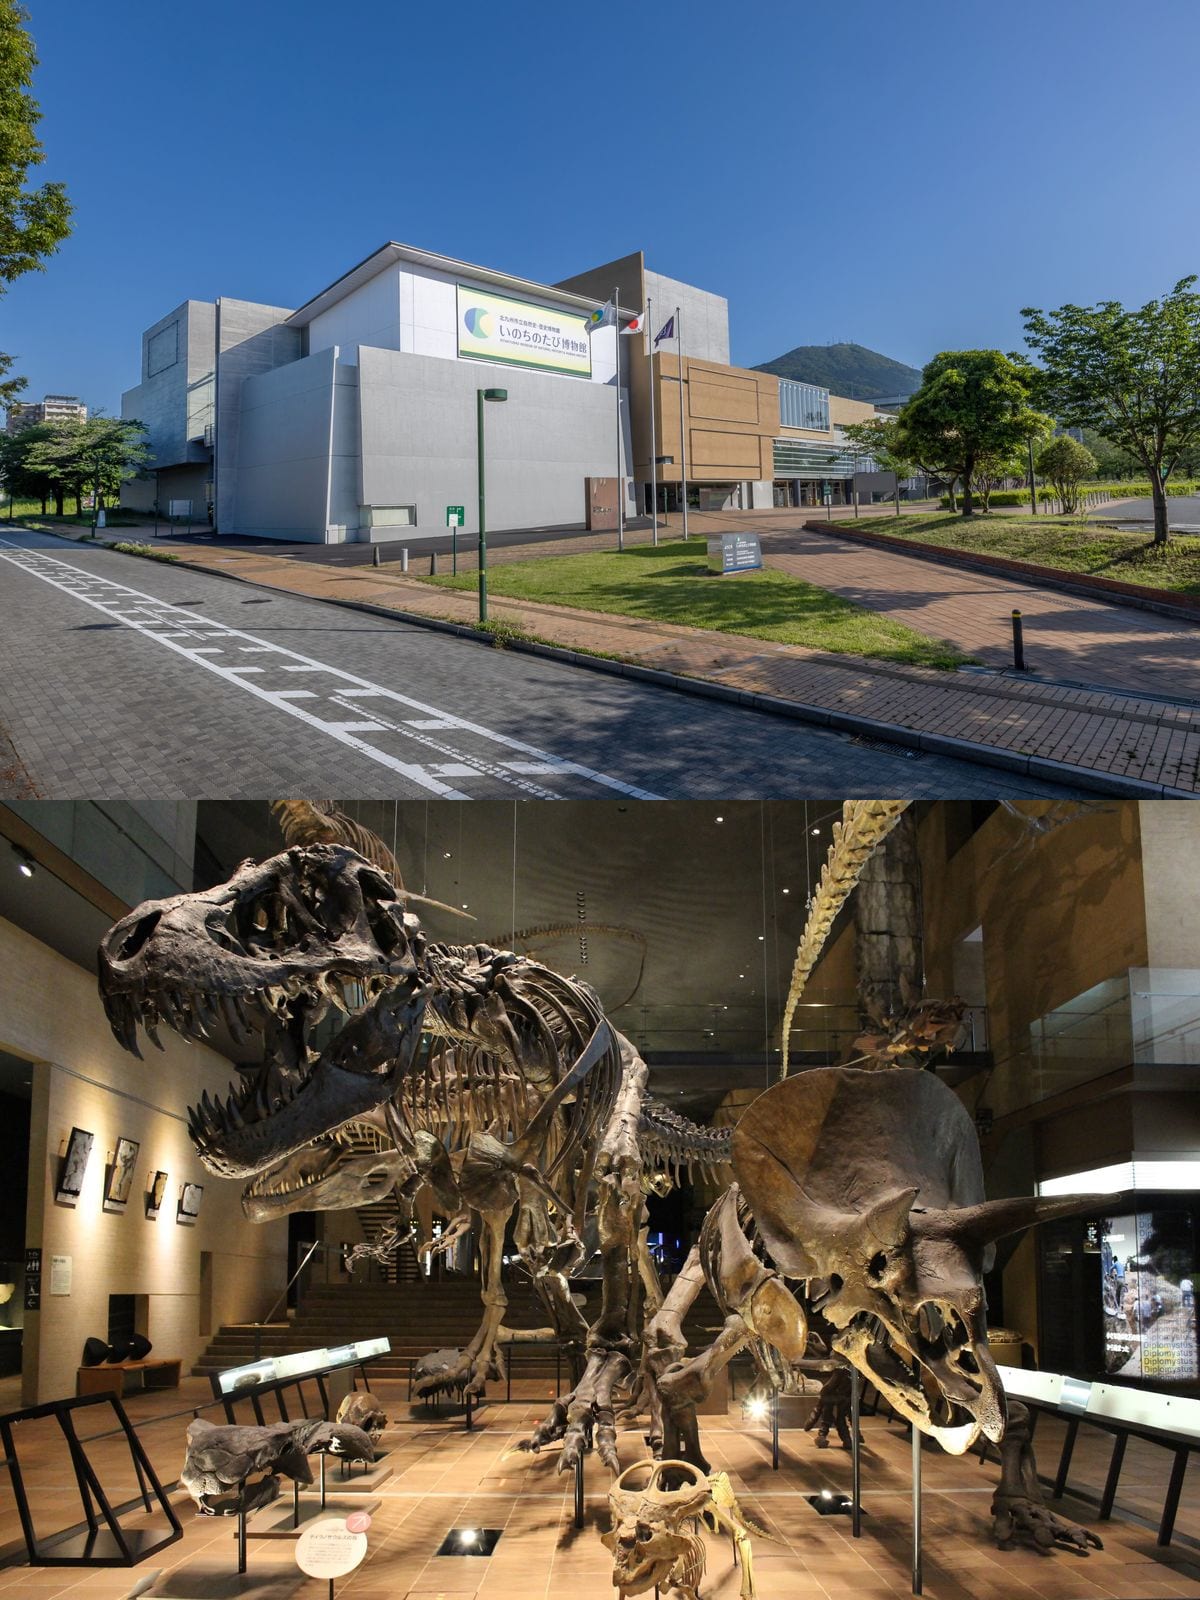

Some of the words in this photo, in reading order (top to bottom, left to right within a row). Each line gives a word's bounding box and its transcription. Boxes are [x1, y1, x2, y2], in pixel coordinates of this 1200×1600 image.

[500, 325, 587, 353] いのちのたび博物館
[1143, 1358, 1194, 1366] Diplomystus
[1144, 1366, 1194, 1374] Diplomystus
